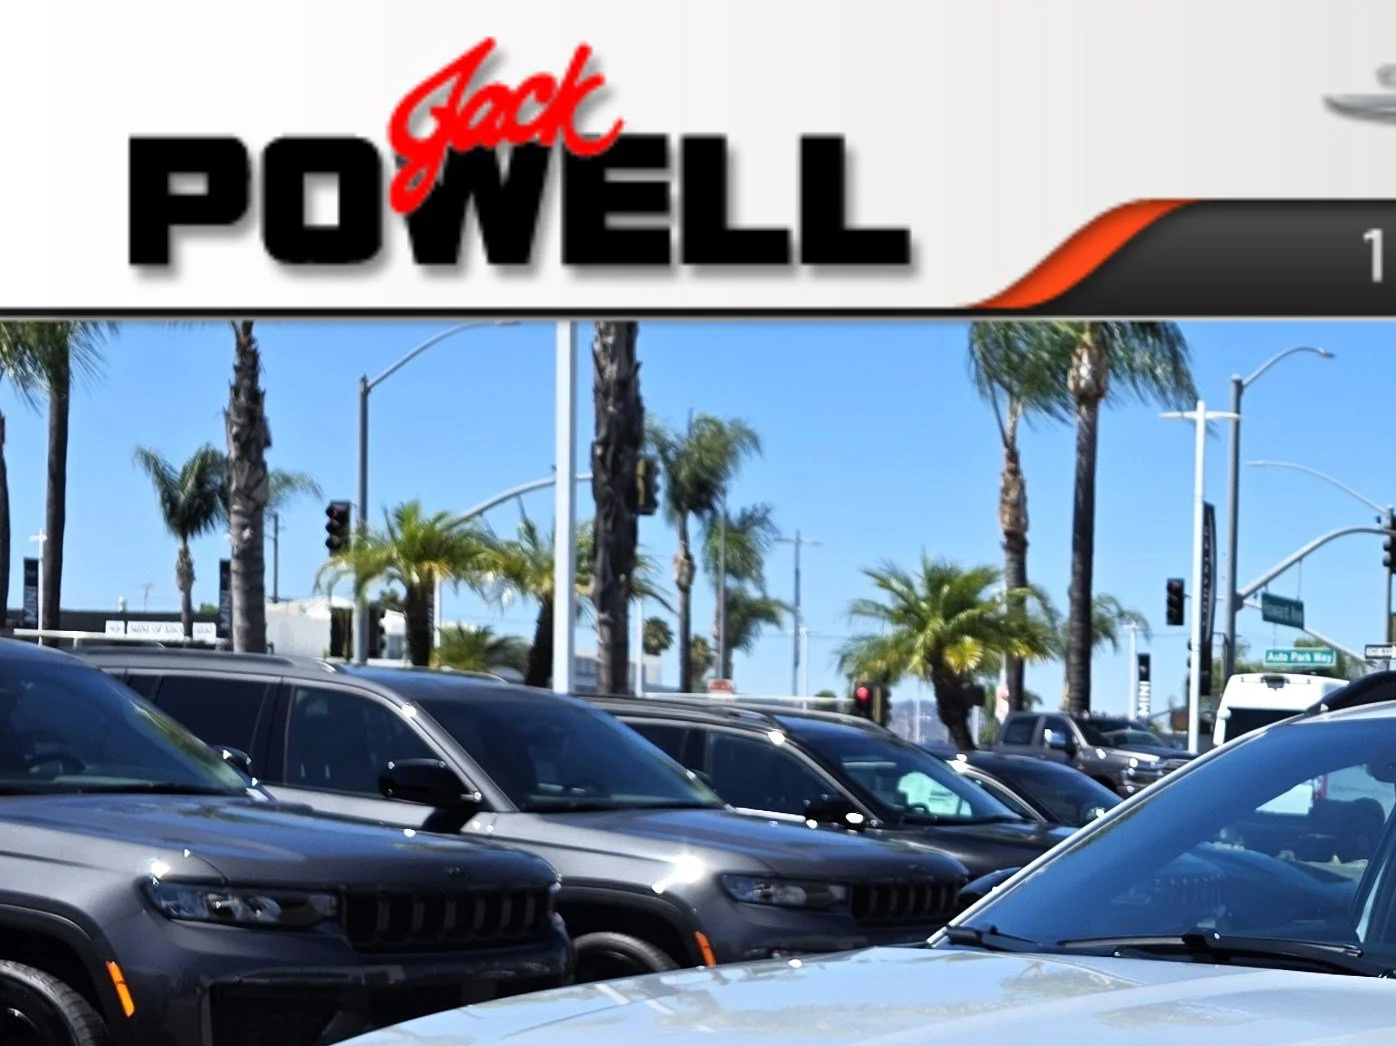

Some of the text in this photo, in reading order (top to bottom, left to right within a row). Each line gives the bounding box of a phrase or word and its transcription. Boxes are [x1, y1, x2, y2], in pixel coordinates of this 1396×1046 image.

[1266, 651, 1333, 664] Auto Park Way
[1138, 680, 1150, 717] MINI
